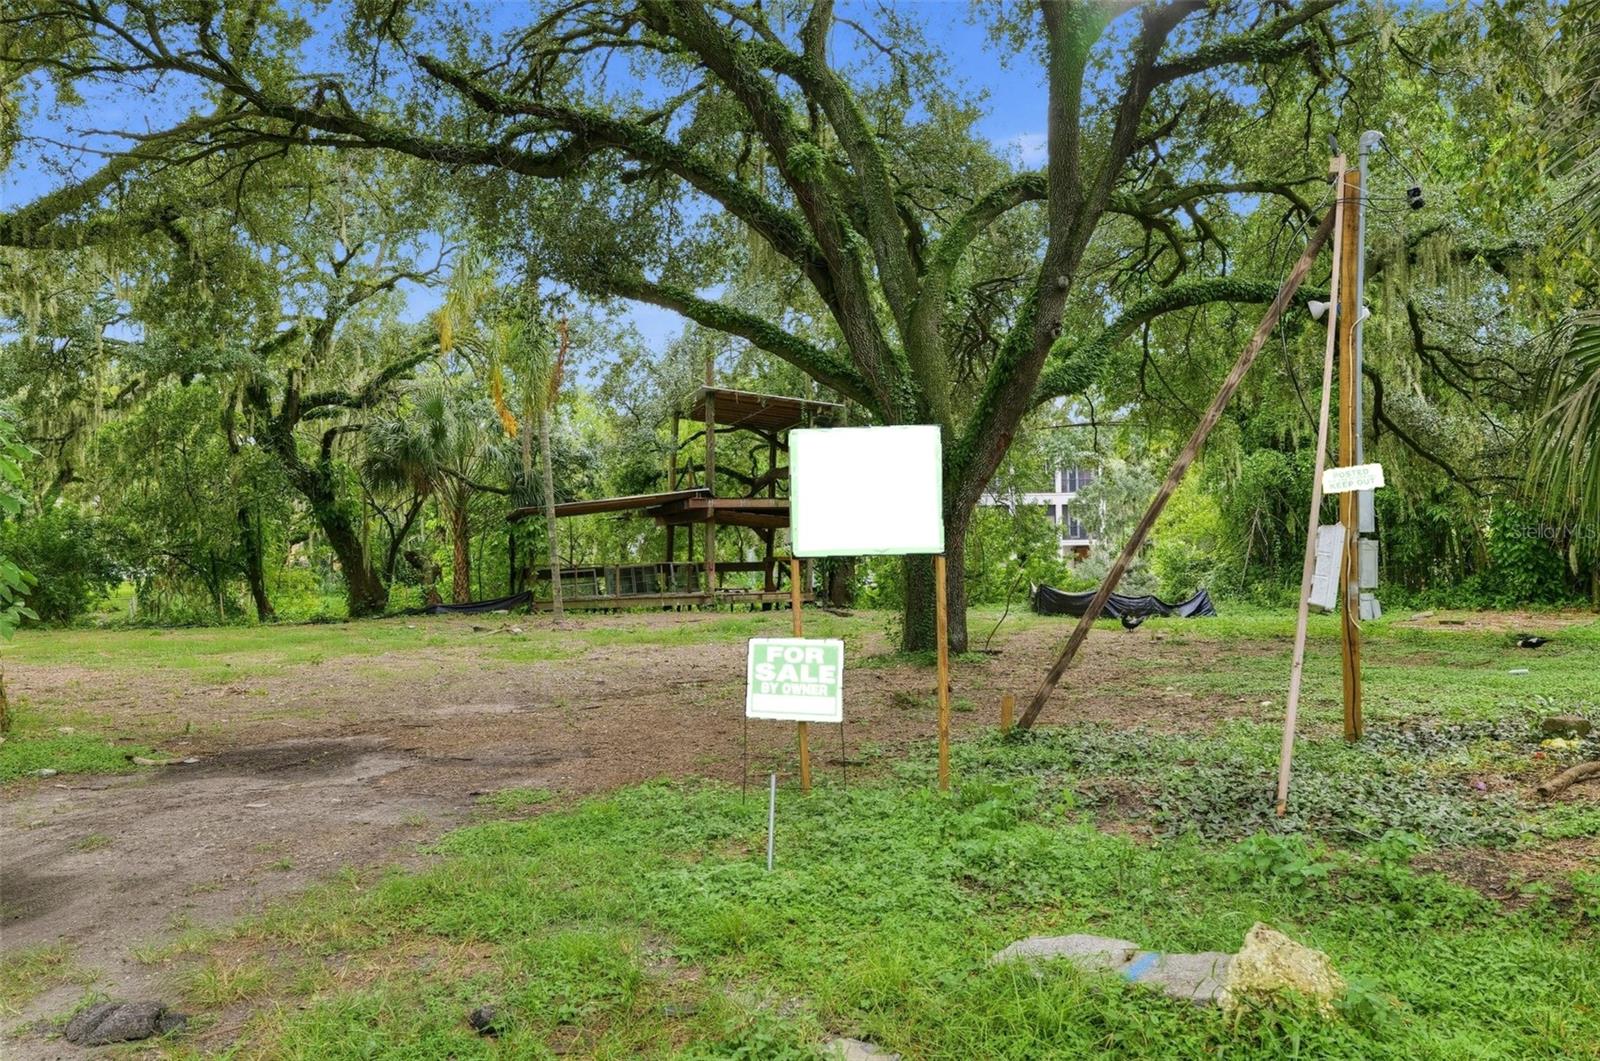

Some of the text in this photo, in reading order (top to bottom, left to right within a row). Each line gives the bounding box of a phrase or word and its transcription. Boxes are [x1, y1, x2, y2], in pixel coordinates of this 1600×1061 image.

[1333, 468, 1369, 479] POSTED
[1329, 480, 1354, 489] KEEP
[1356, 477, 1376, 486] OUT
[766, 646, 825, 664] FOR
[754, 662, 836, 684] SALE
[760, 682, 828, 697] BY OWNER
